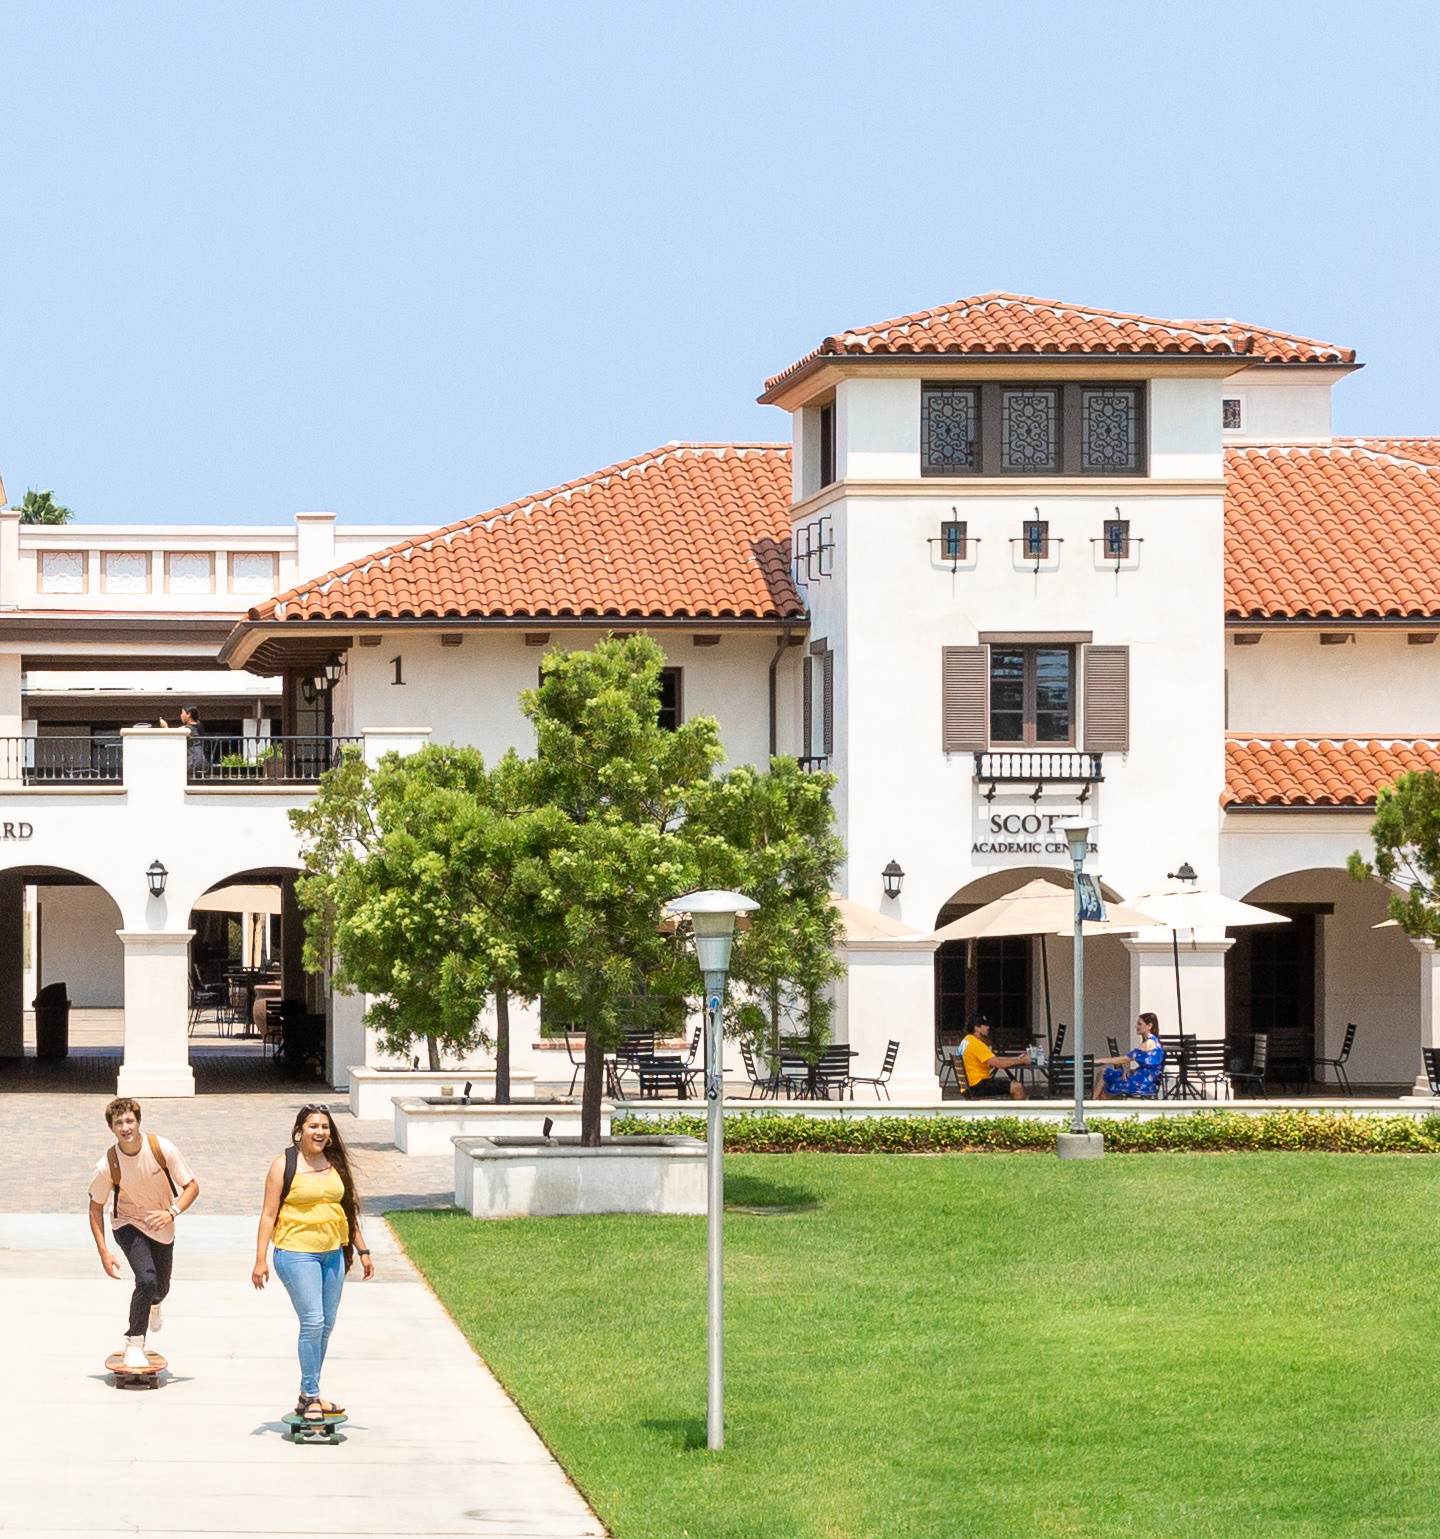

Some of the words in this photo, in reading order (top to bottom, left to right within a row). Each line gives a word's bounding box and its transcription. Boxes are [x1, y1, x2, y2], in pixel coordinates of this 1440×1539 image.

[389, 655, 407, 686] 1
[971, 842, 1042, 853] ACADEMIC
[1044, 842, 1099, 853] CENER
